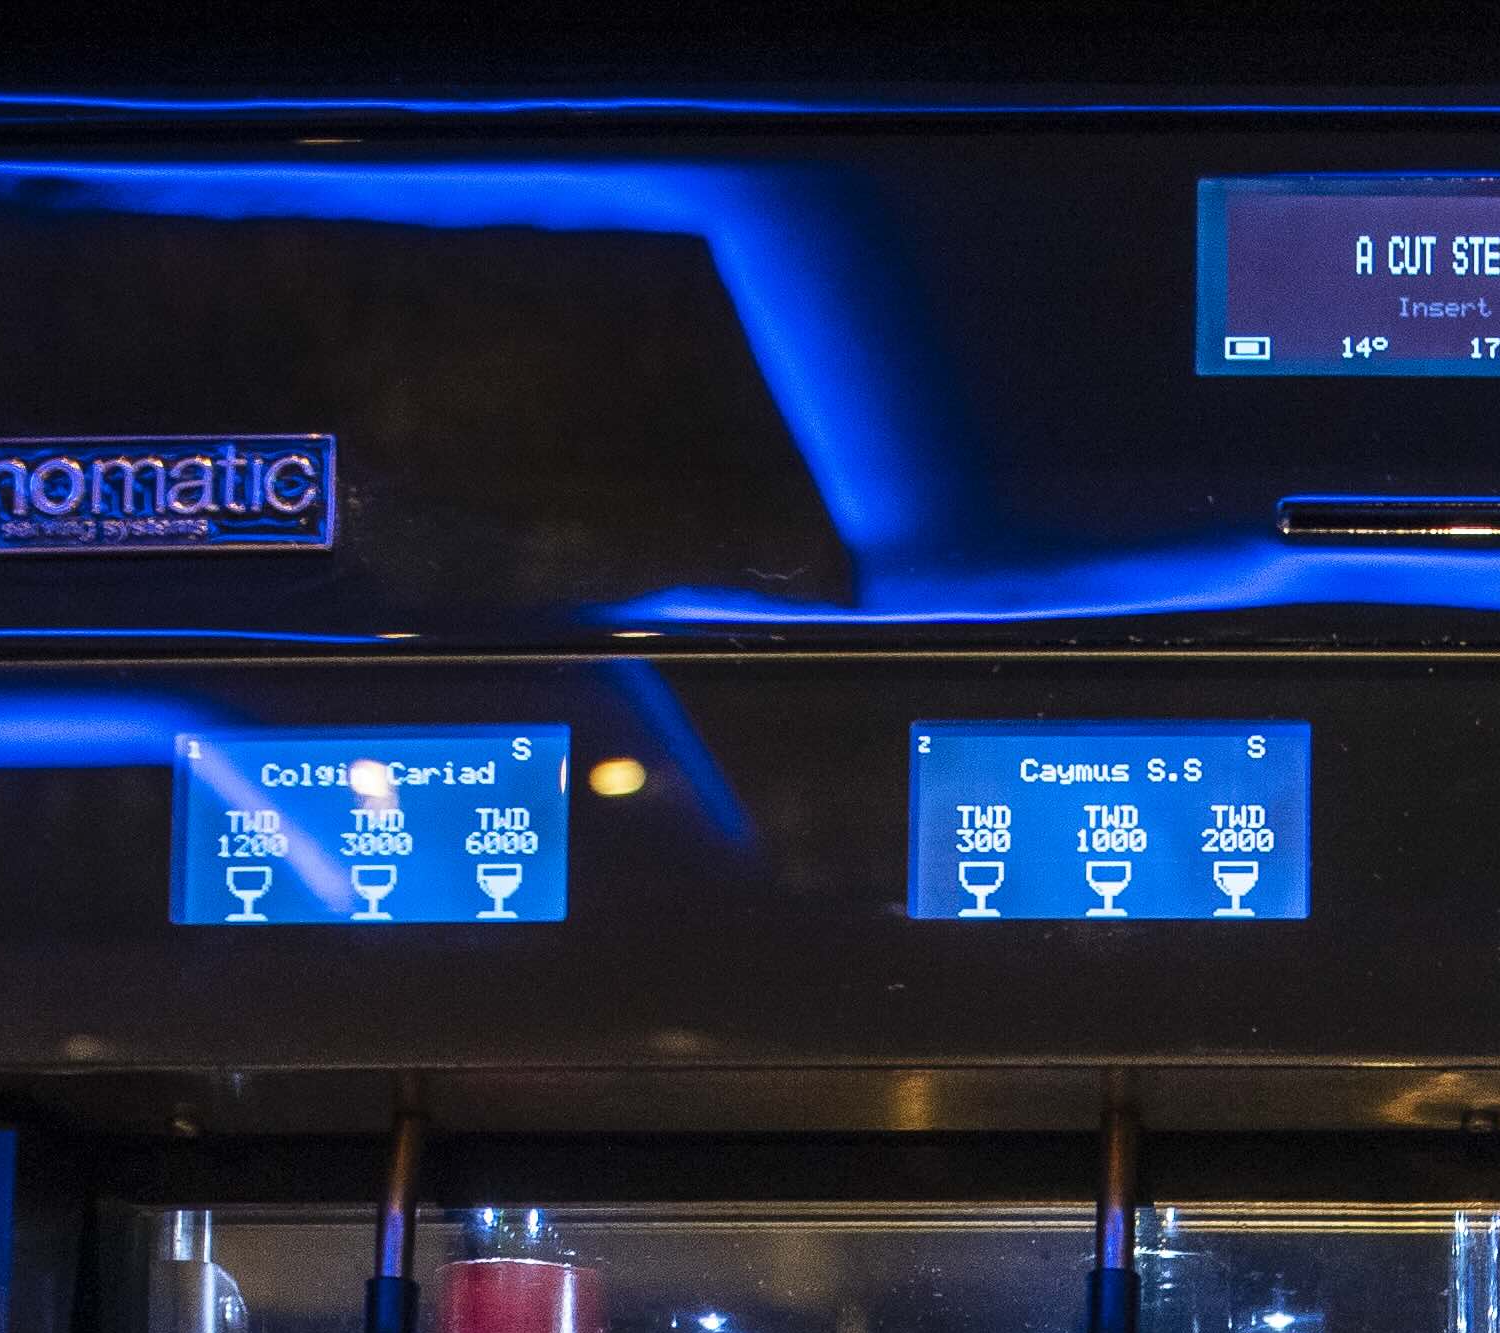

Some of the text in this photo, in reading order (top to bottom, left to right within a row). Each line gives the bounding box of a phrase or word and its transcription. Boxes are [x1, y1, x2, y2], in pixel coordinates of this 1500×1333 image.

[1355, 235, 1373, 275] A
[1388, 235, 1436, 275] CUT
[1399, 297, 1492, 319] Insert
[187, 740, 201, 760] 1
[511, 736, 532, 761] S
[917, 735, 931, 754] 2
[1246, 734, 1266, 759] S
[261, 761, 496, 788] Colgi Cariad
[1019, 758, 1203, 785] Caymus S.S
[225, 807, 530, 833] TWD TWD TWD
[956, 804, 1266, 829] TWD TWD TWD
[217, 831, 538, 858] 1200 3000 6000
[956, 828, 1275, 853] 300 1000 2000
